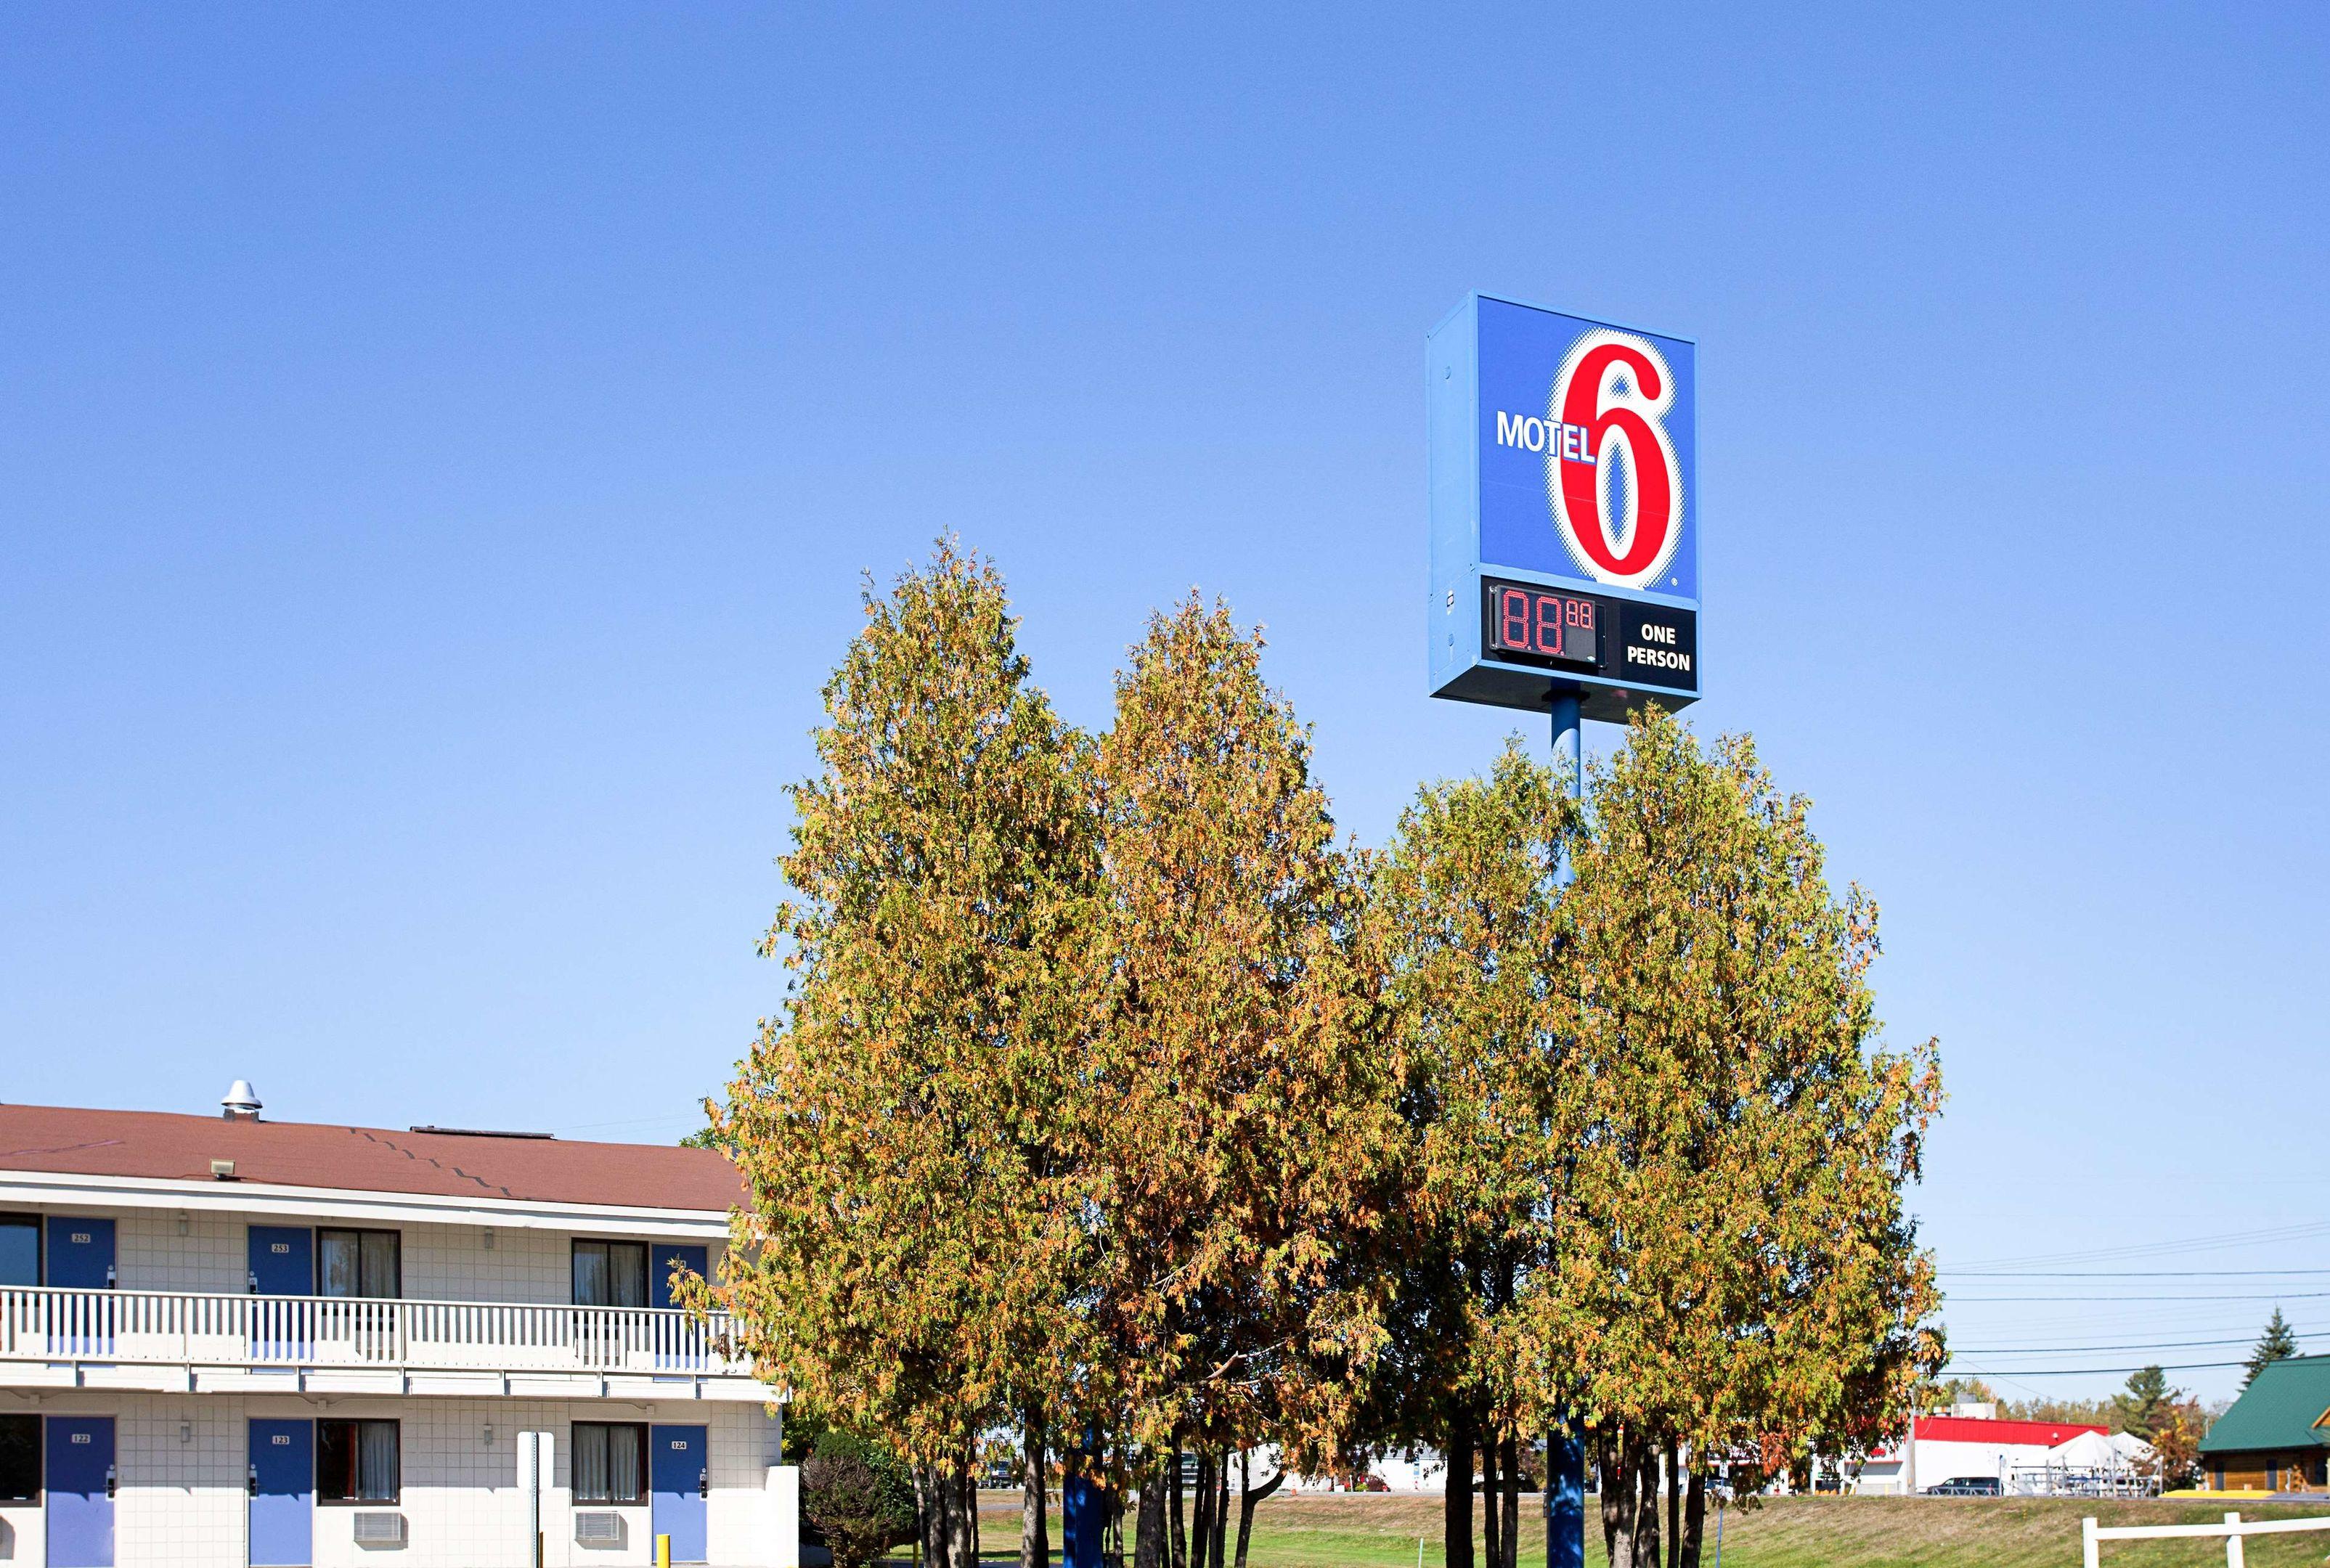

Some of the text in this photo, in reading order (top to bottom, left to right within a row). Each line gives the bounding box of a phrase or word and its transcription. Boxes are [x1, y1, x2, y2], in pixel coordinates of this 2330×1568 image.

[1496, 343, 1671, 576] MOTEL 6
[1641, 624, 1676, 645] ONE
[1627, 645, 1690, 671] PERSON
